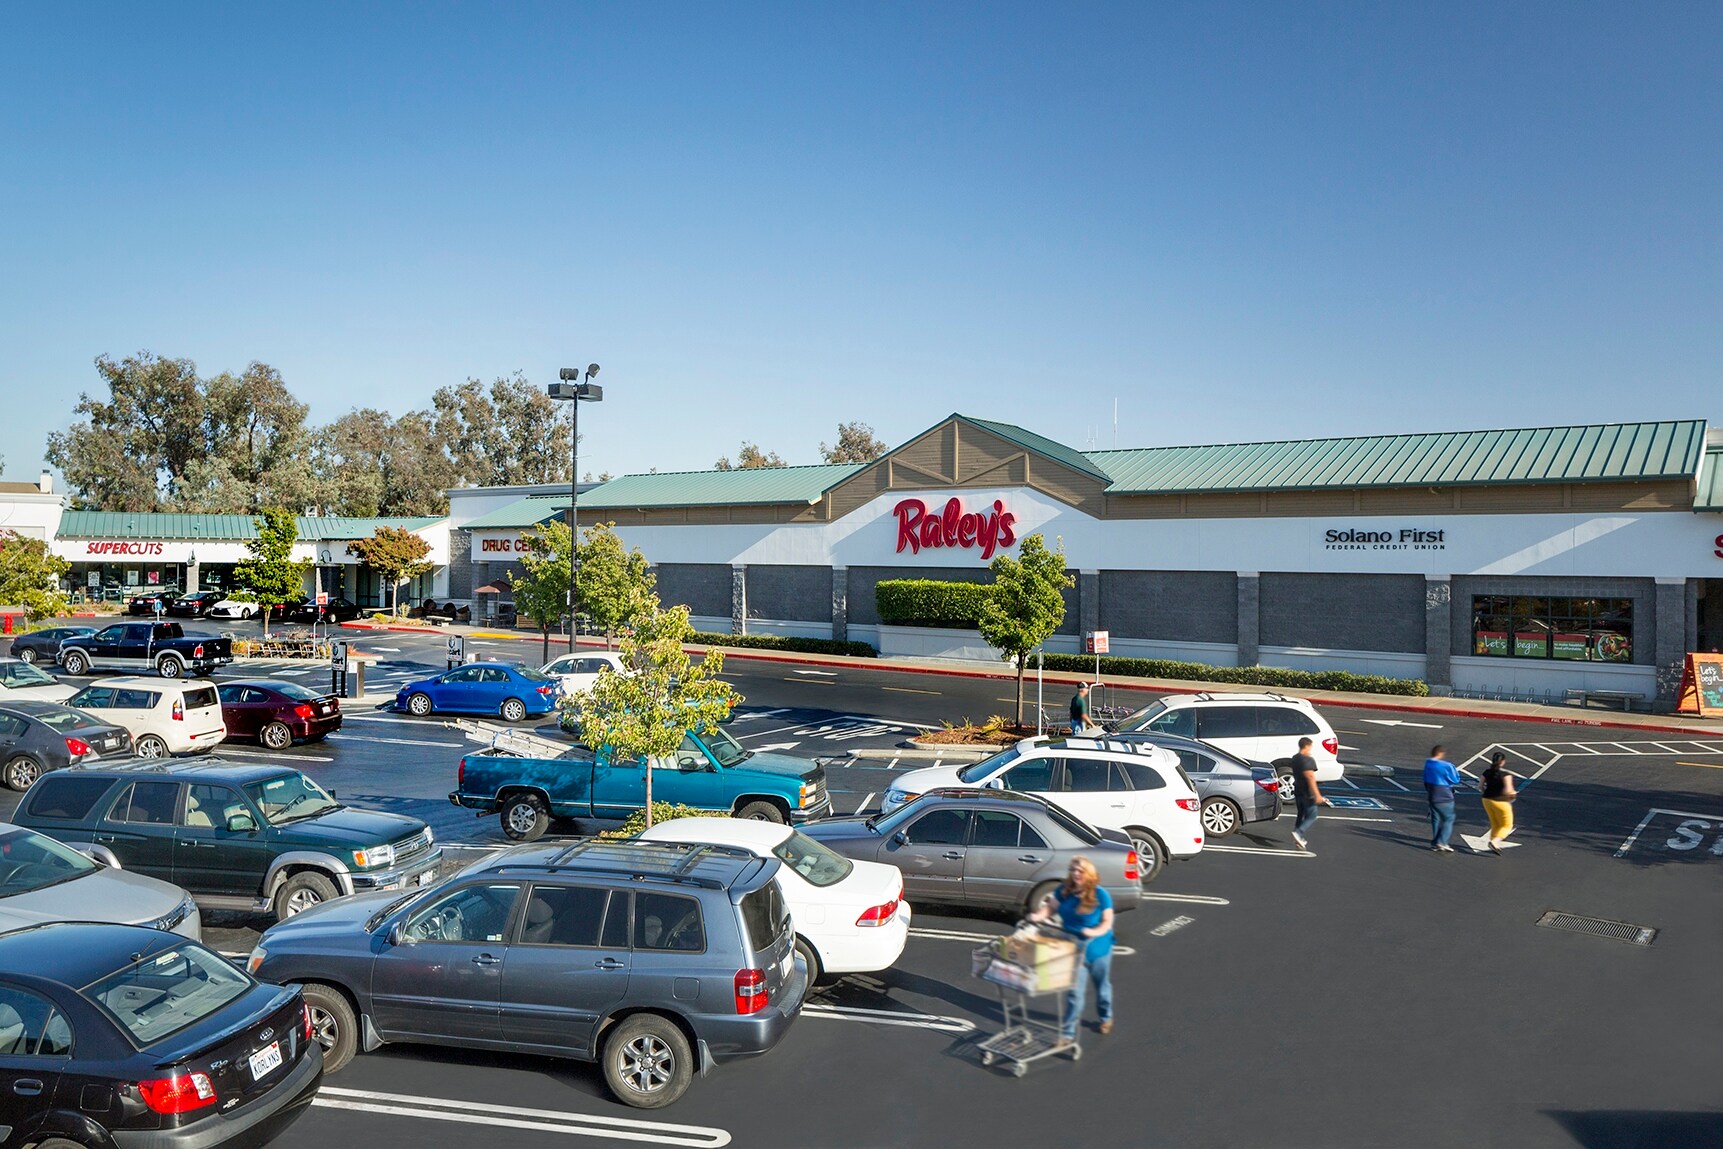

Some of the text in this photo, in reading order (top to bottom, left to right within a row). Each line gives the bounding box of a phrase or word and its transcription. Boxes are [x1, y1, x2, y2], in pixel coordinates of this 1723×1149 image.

[893, 497, 1017, 560] Raley's
[1325, 528, 1445, 543] Solano First
[86, 542, 163, 555] SUPERCUTS
[482, 539, 511, 552] DRUG
[1484, 635, 1506, 649] Let's
[1149, 915, 1196, 937] COMPACT
